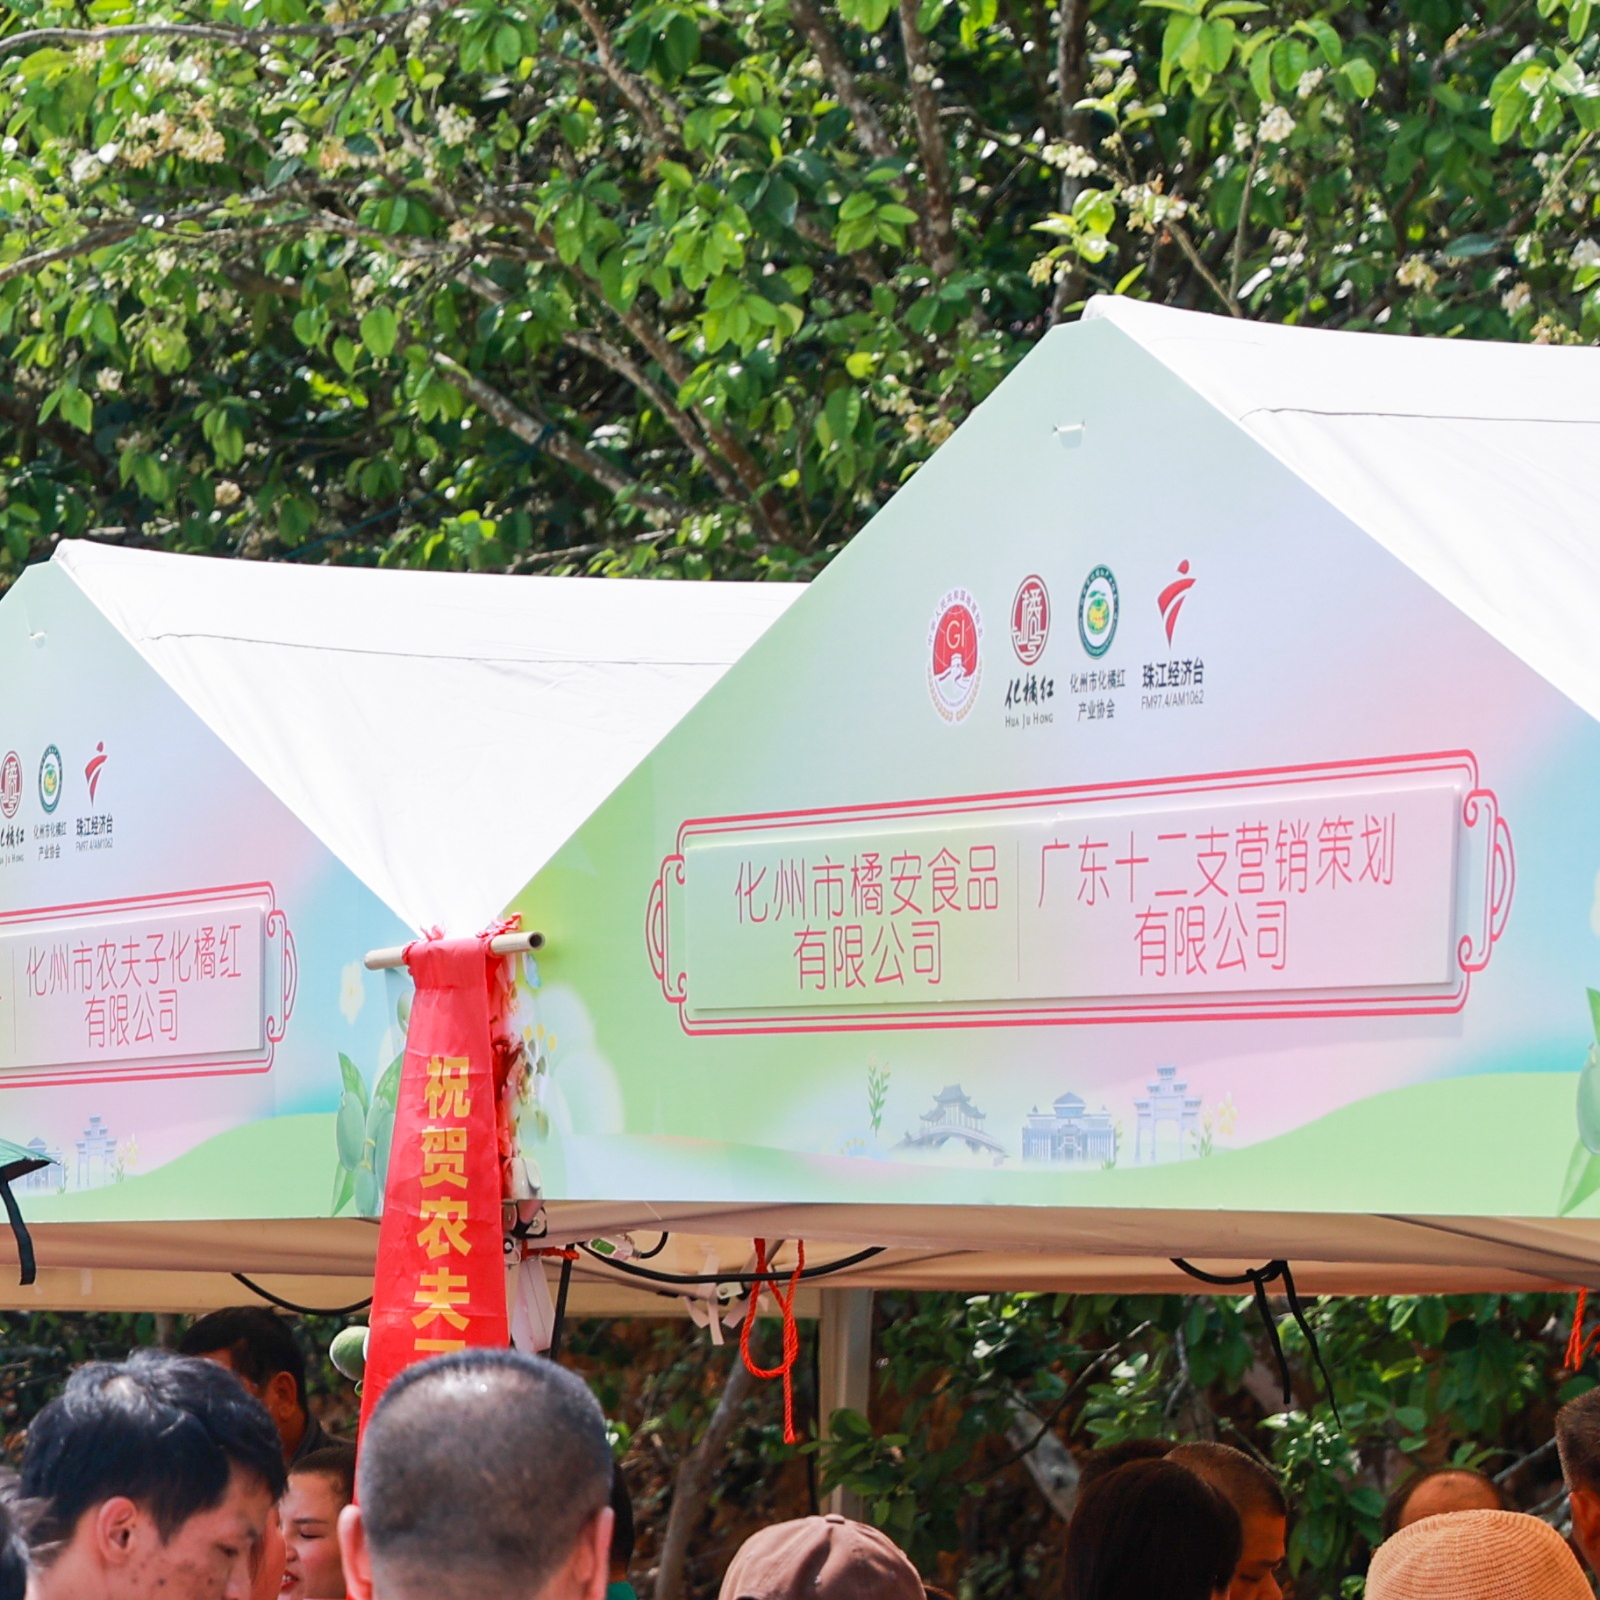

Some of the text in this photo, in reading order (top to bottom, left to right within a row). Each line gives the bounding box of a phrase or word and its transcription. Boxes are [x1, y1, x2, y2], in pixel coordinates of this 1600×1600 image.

[1070, 668, 1125, 694] 化州市化橘红
[1142, 656, 1204, 691] 珠江经济台
[1077, 698, 1114, 722] 产业协会
[76, 813, 113, 837] 珠江经济台
[735, 845, 999, 924] 化州市橘安食品
[1038, 811, 1396, 907] 广东十二支营销策划
[26, 924, 242, 997] 化州市农夫子化橘红
[793, 921, 942, 989] 有限公司
[1134, 900, 1287, 977] 有限公司
[84, 989, 179, 1049] 有限公司
